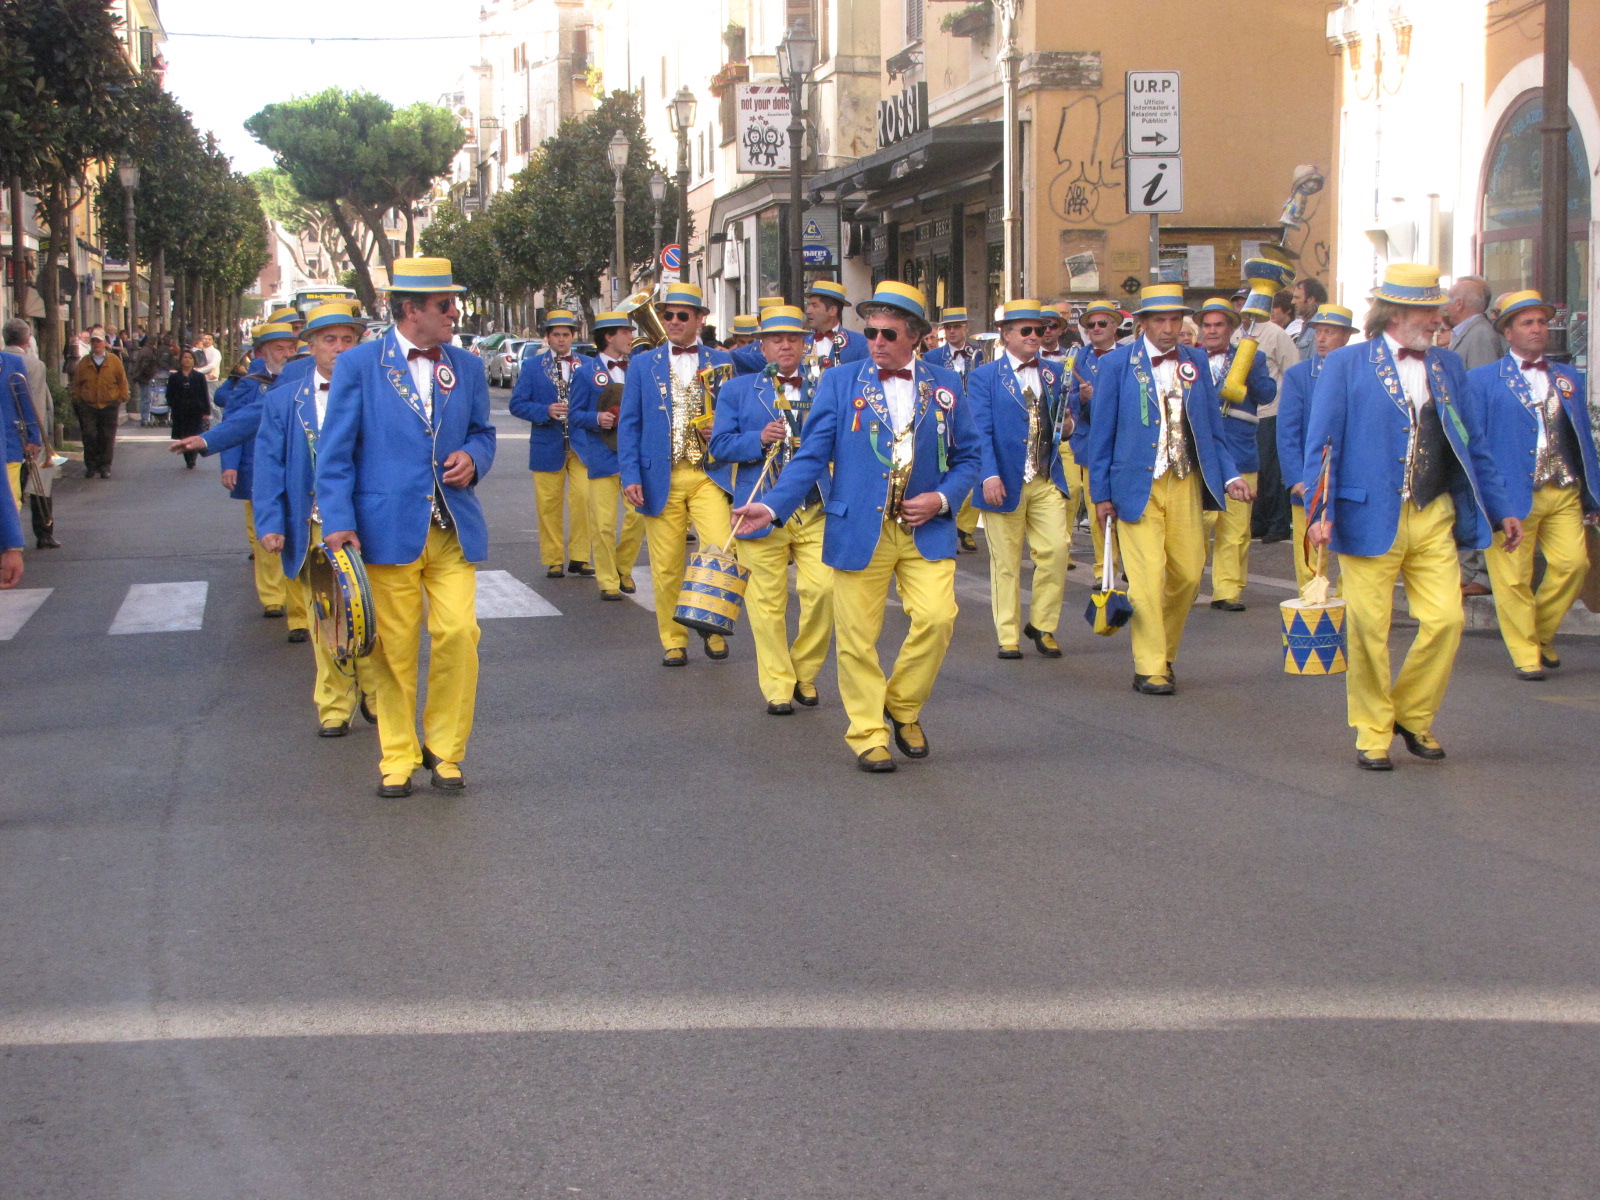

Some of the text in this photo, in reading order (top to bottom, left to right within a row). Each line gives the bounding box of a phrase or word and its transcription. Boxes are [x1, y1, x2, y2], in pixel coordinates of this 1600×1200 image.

[1133, 79, 1175, 93] U.R.P.
[741, 96, 790, 112] not your dolls
[876, 82, 920, 149] ROSSI
